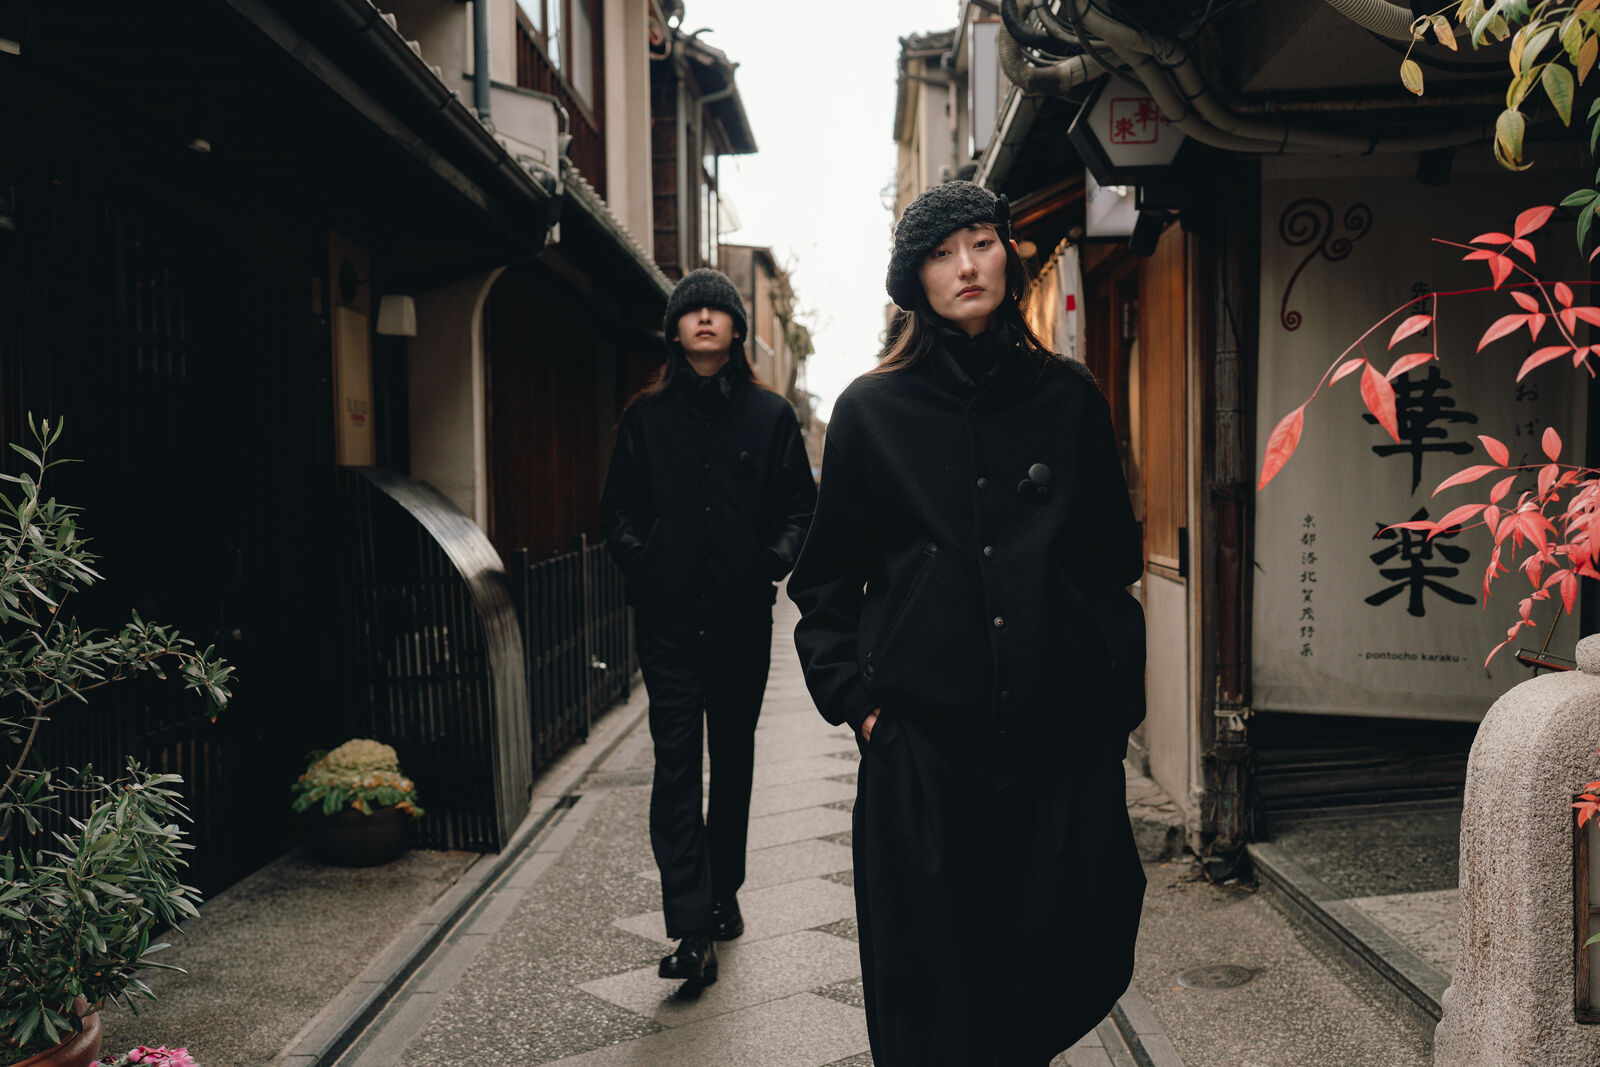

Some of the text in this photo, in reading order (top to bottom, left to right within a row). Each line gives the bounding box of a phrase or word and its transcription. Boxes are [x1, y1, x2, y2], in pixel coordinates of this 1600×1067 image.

[1362, 366, 1478, 617] 華楽
[1366, 650, 1460, 662] pontocho karaku
